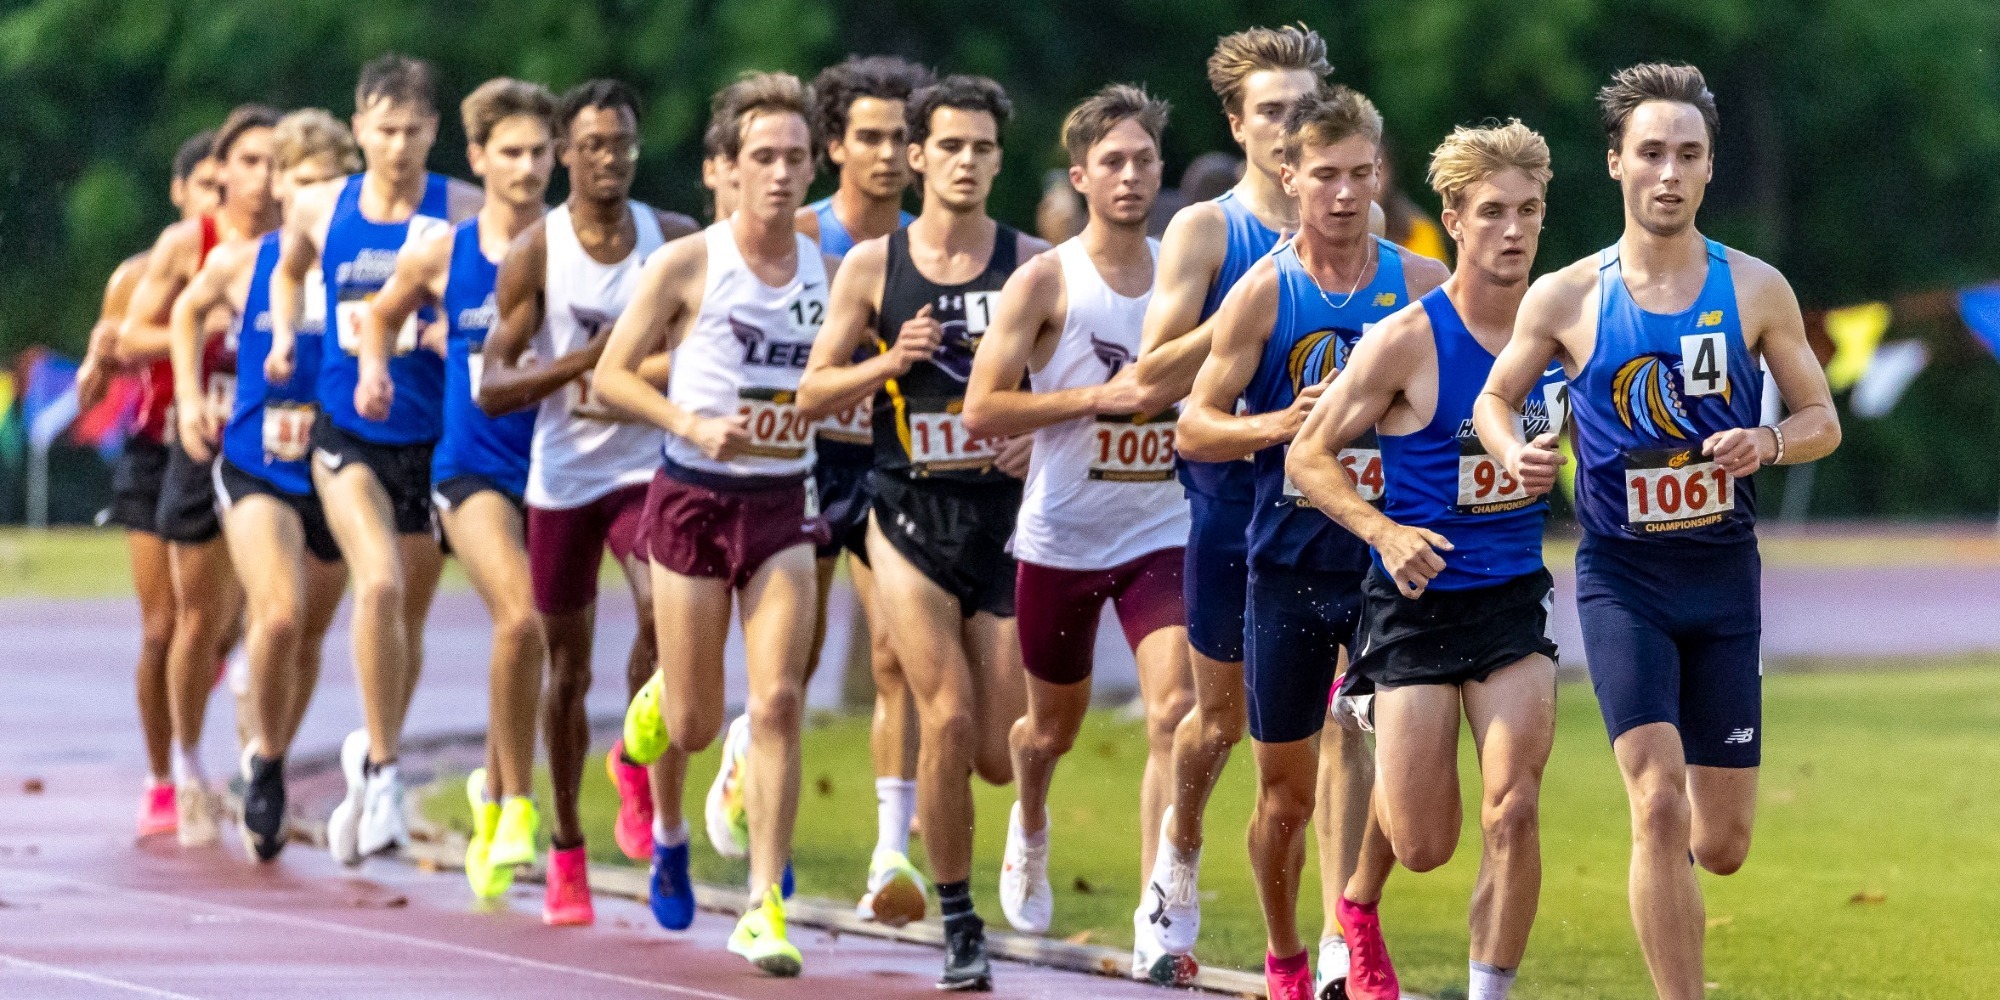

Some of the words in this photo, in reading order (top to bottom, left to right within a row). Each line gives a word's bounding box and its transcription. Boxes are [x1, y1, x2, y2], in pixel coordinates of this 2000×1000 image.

[789, 299, 825, 325] 12
[743, 340, 813, 369] LEE
[1692, 337, 1720, 390] 4
[915, 420, 1004, 455] 112
[1097, 429, 1175, 465] 1003
[1668, 450, 1690, 468] GSC
[1631, 467, 1727, 515] 1061
[1645, 513, 1722, 533] CHAMPIONSHIPS
